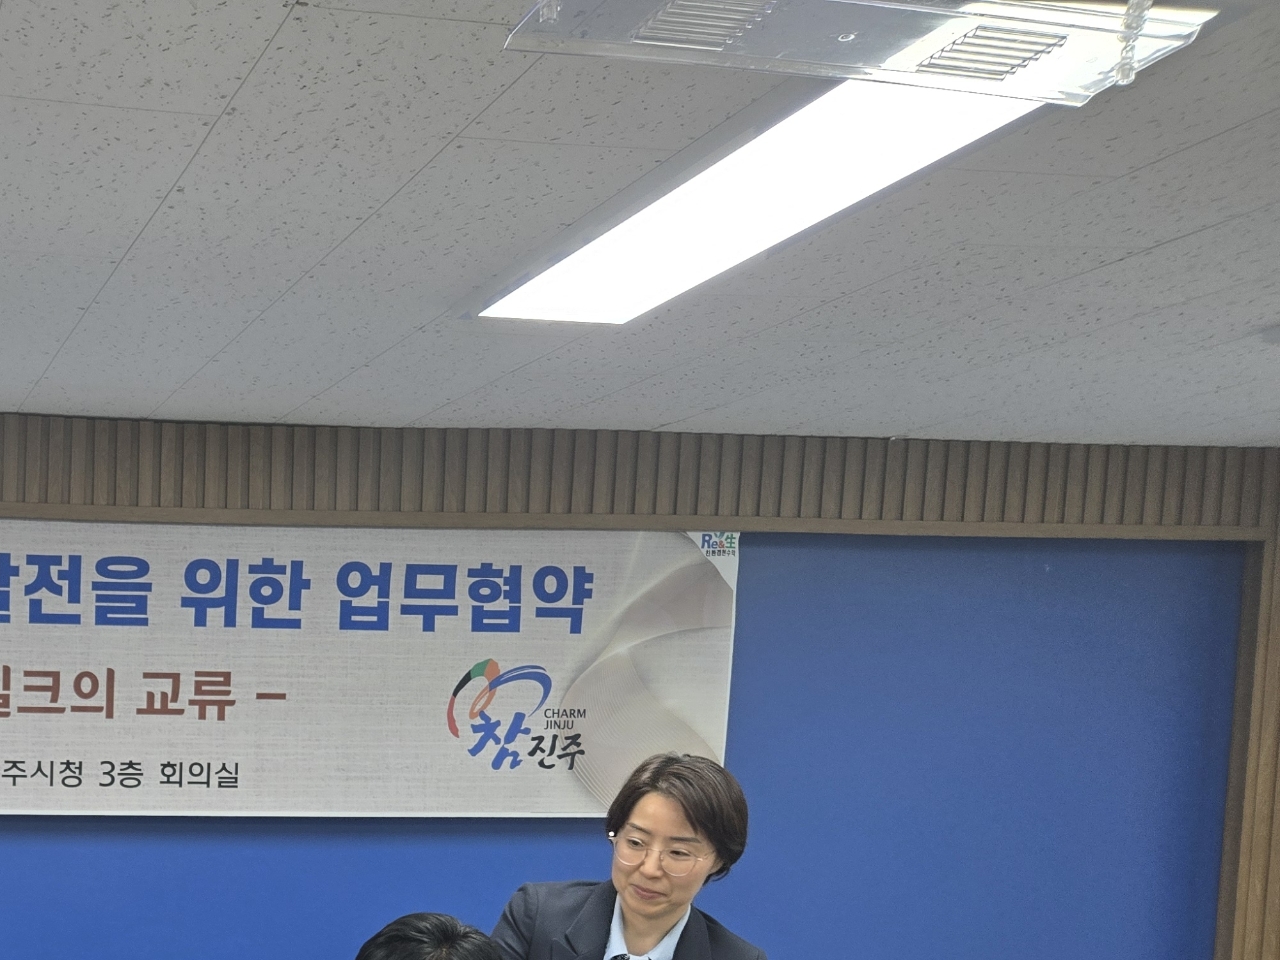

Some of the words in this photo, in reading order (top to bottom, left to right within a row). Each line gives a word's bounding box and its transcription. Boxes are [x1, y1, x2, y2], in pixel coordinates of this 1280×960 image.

[180, 558, 311, 629] 위한
[336, 561, 593, 634] 업무협약
[137, 671, 235, 721] 교류
[543, 708, 587, 719] CHARM
[468, 710, 531, 770] 참
[527, 734, 585, 770] 진주
[543, 719, 575, 731] JINJU
[98, 759, 144, 789] 3층
[159, 760, 239, 789] 회의실
